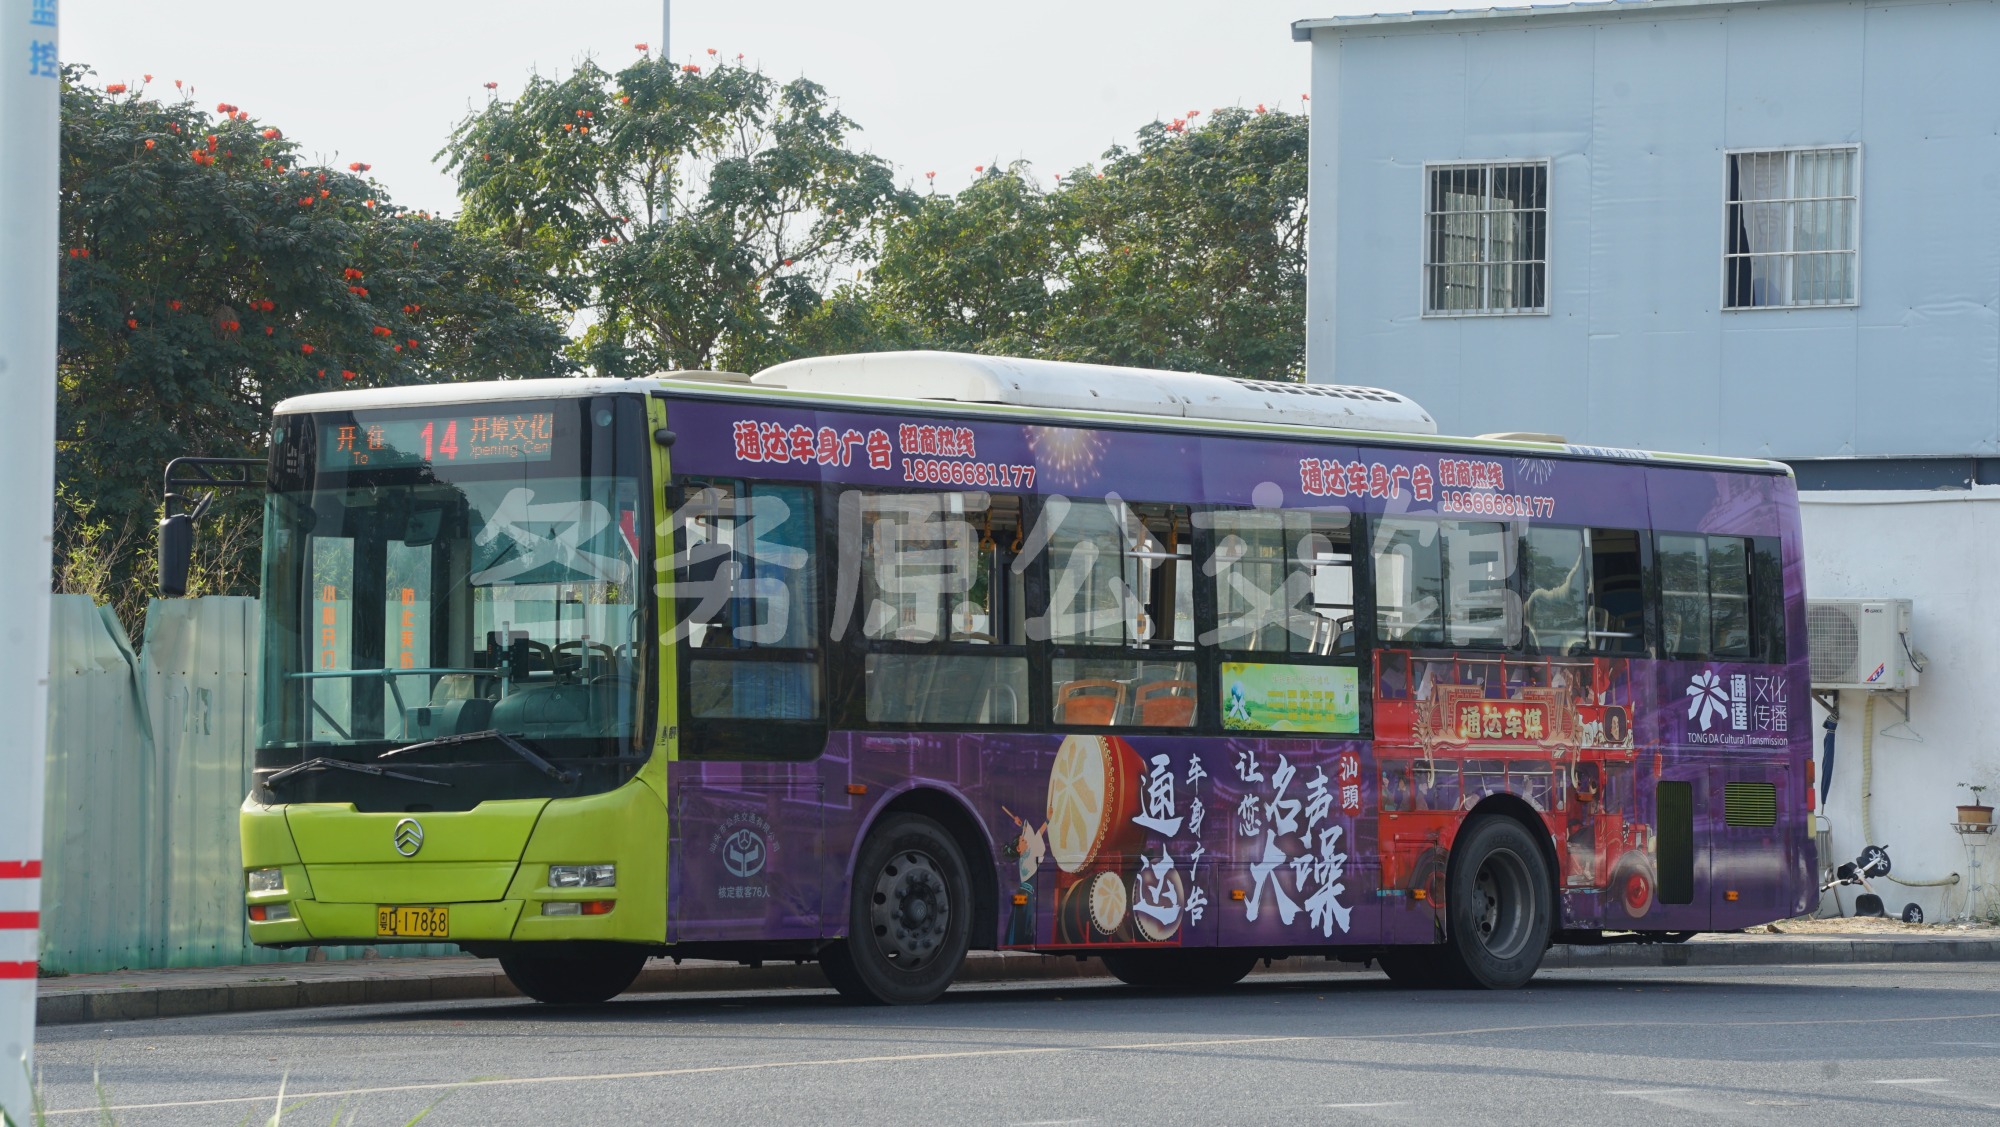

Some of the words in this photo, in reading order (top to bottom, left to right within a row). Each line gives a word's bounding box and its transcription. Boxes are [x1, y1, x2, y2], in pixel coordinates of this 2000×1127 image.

[336, 425, 385, 451] 开往
[421, 421, 458, 461] 14
[470, 413, 553, 443] 开埠文化
[899, 423, 976, 458] 招商热线
[353, 451, 368, 465] To
[523, 440, 552, 454] Cen
[733, 420, 892, 471] 通达车身广告
[902, 458, 1036, 489] 18666681177
[1300, 458, 1433, 502] 通达车身广告
[1439, 459, 1504, 490] 招商热线
[1442, 490, 1555, 518] 18666681177
[1754, 675, 1787, 703] 文化
[1461, 705, 1543, 739] 通达车媒
[1754, 704, 1787, 731] 传播
[1688, 732, 1707, 743] TONG
[1708, 733, 1719, 743] DA
[1720, 733, 1745, 744] Cultural
[1746, 734, 1788, 745] Transmission
[1235, 751, 1264, 837] 让您
[1341, 756, 1359, 811] 汕頭
[709, 812, 780, 853] 汕头市公共交通有限公司
[1132, 753, 1184, 925] 通达
[1184, 753, 1208, 927] 车身广告
